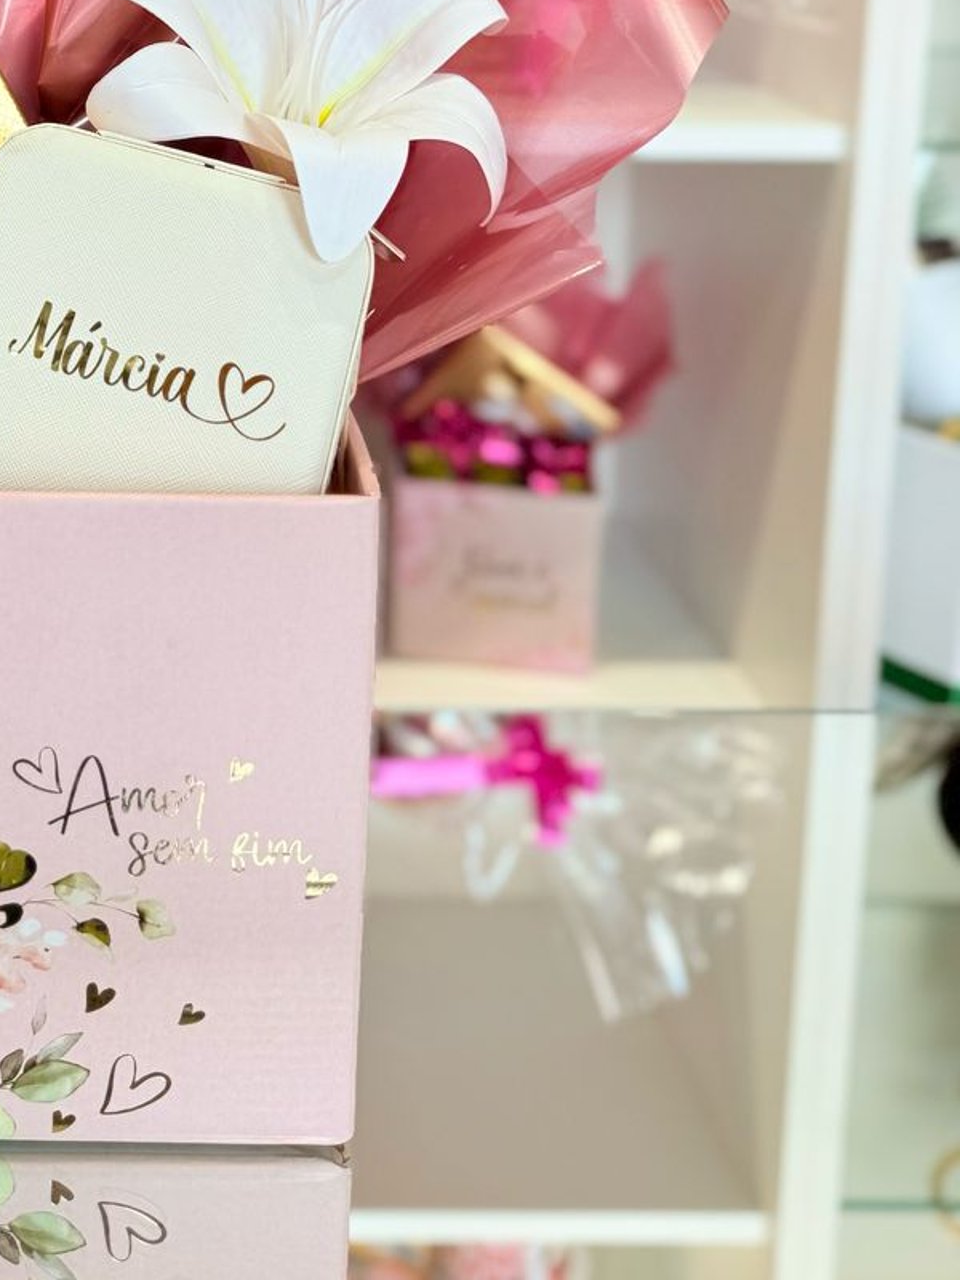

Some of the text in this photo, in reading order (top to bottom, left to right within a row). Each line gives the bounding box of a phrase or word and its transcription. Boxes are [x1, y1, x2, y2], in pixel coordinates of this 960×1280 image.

[8, 300, 198, 408] Márcia
[48, 755, 206, 836] Amor
[230, 832, 312, 873] fim
